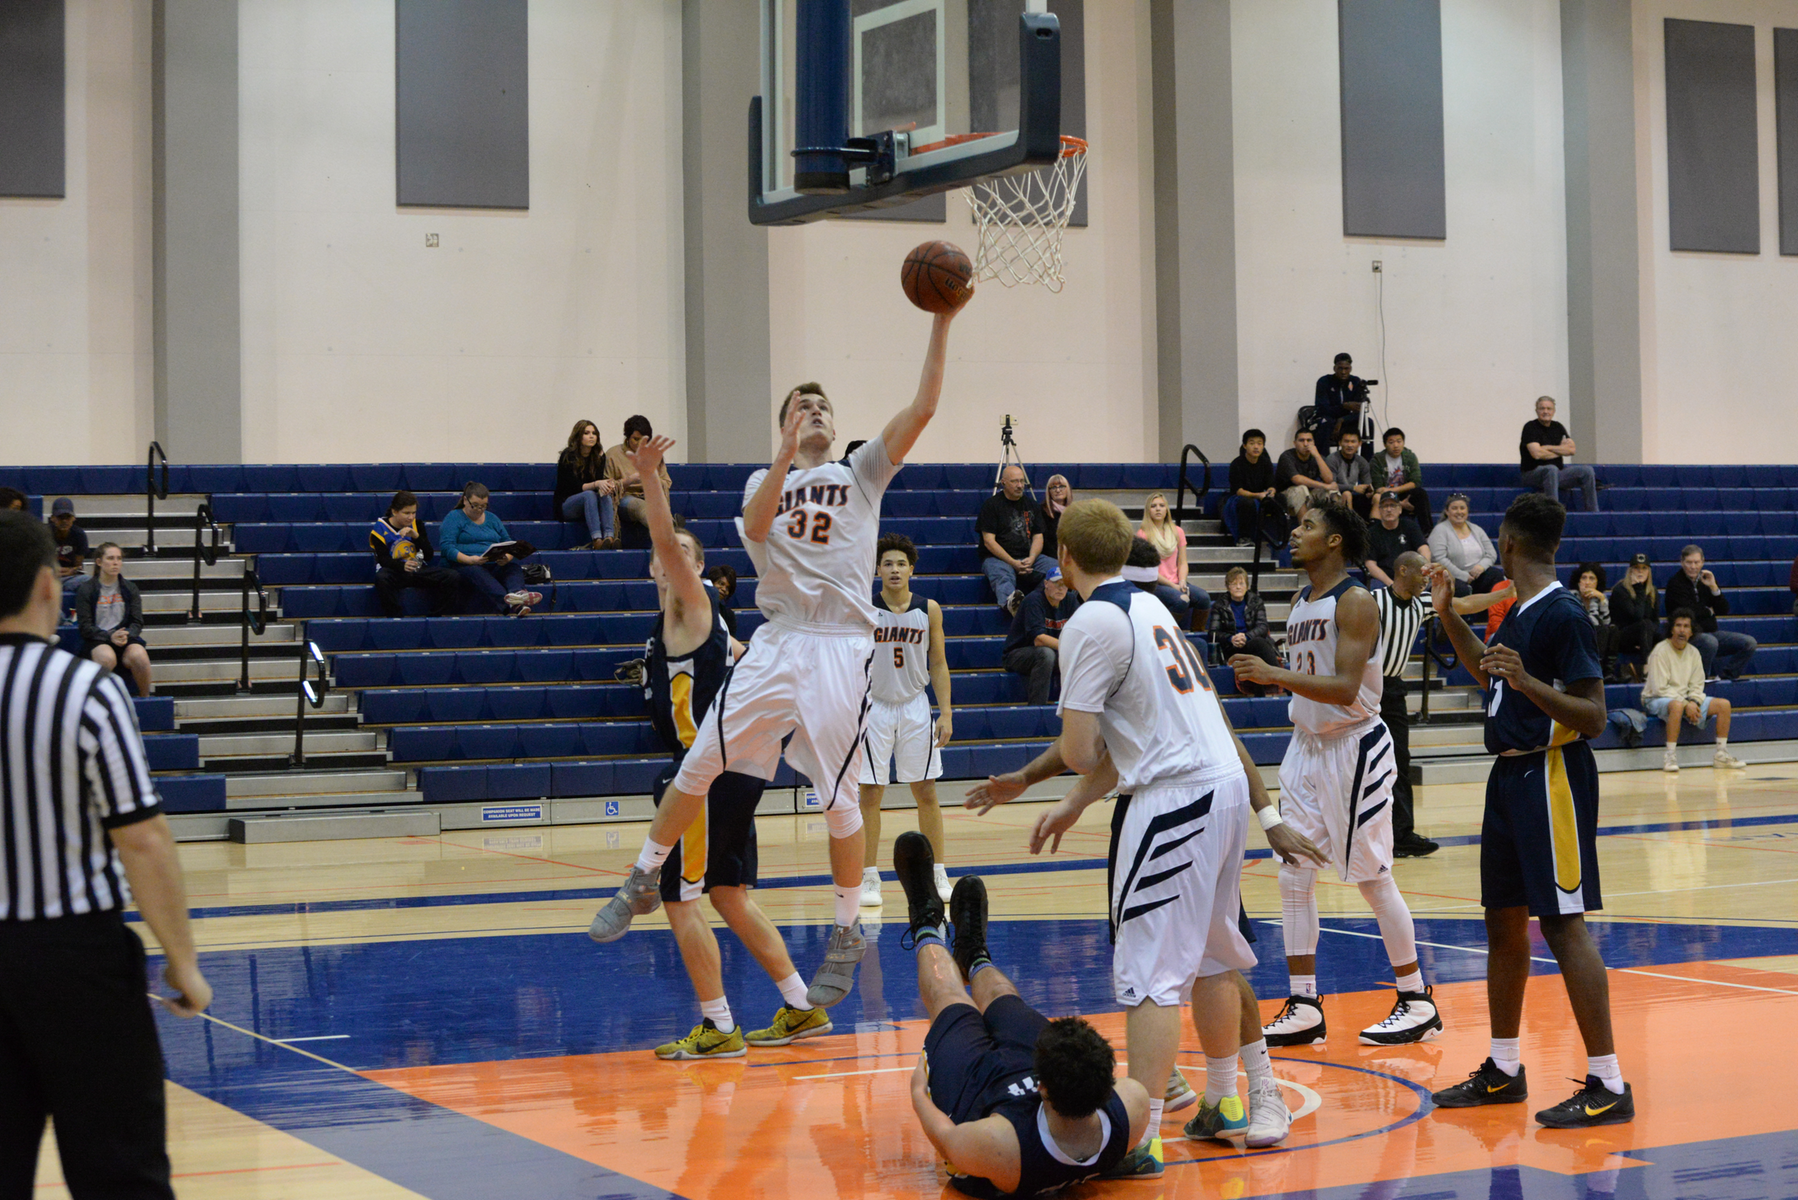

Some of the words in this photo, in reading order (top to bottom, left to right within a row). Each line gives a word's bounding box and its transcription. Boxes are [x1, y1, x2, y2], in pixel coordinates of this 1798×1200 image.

[787, 508, 832, 545] 32
[403, 545, 416, 555] 30
[874, 626, 926, 645] GIANTS
[1287, 618, 1330, 647] GIANTS
[893, 646, 904, 669] 5
[1152, 624, 1213, 695] 30
[1296, 650, 1317, 676] 23
